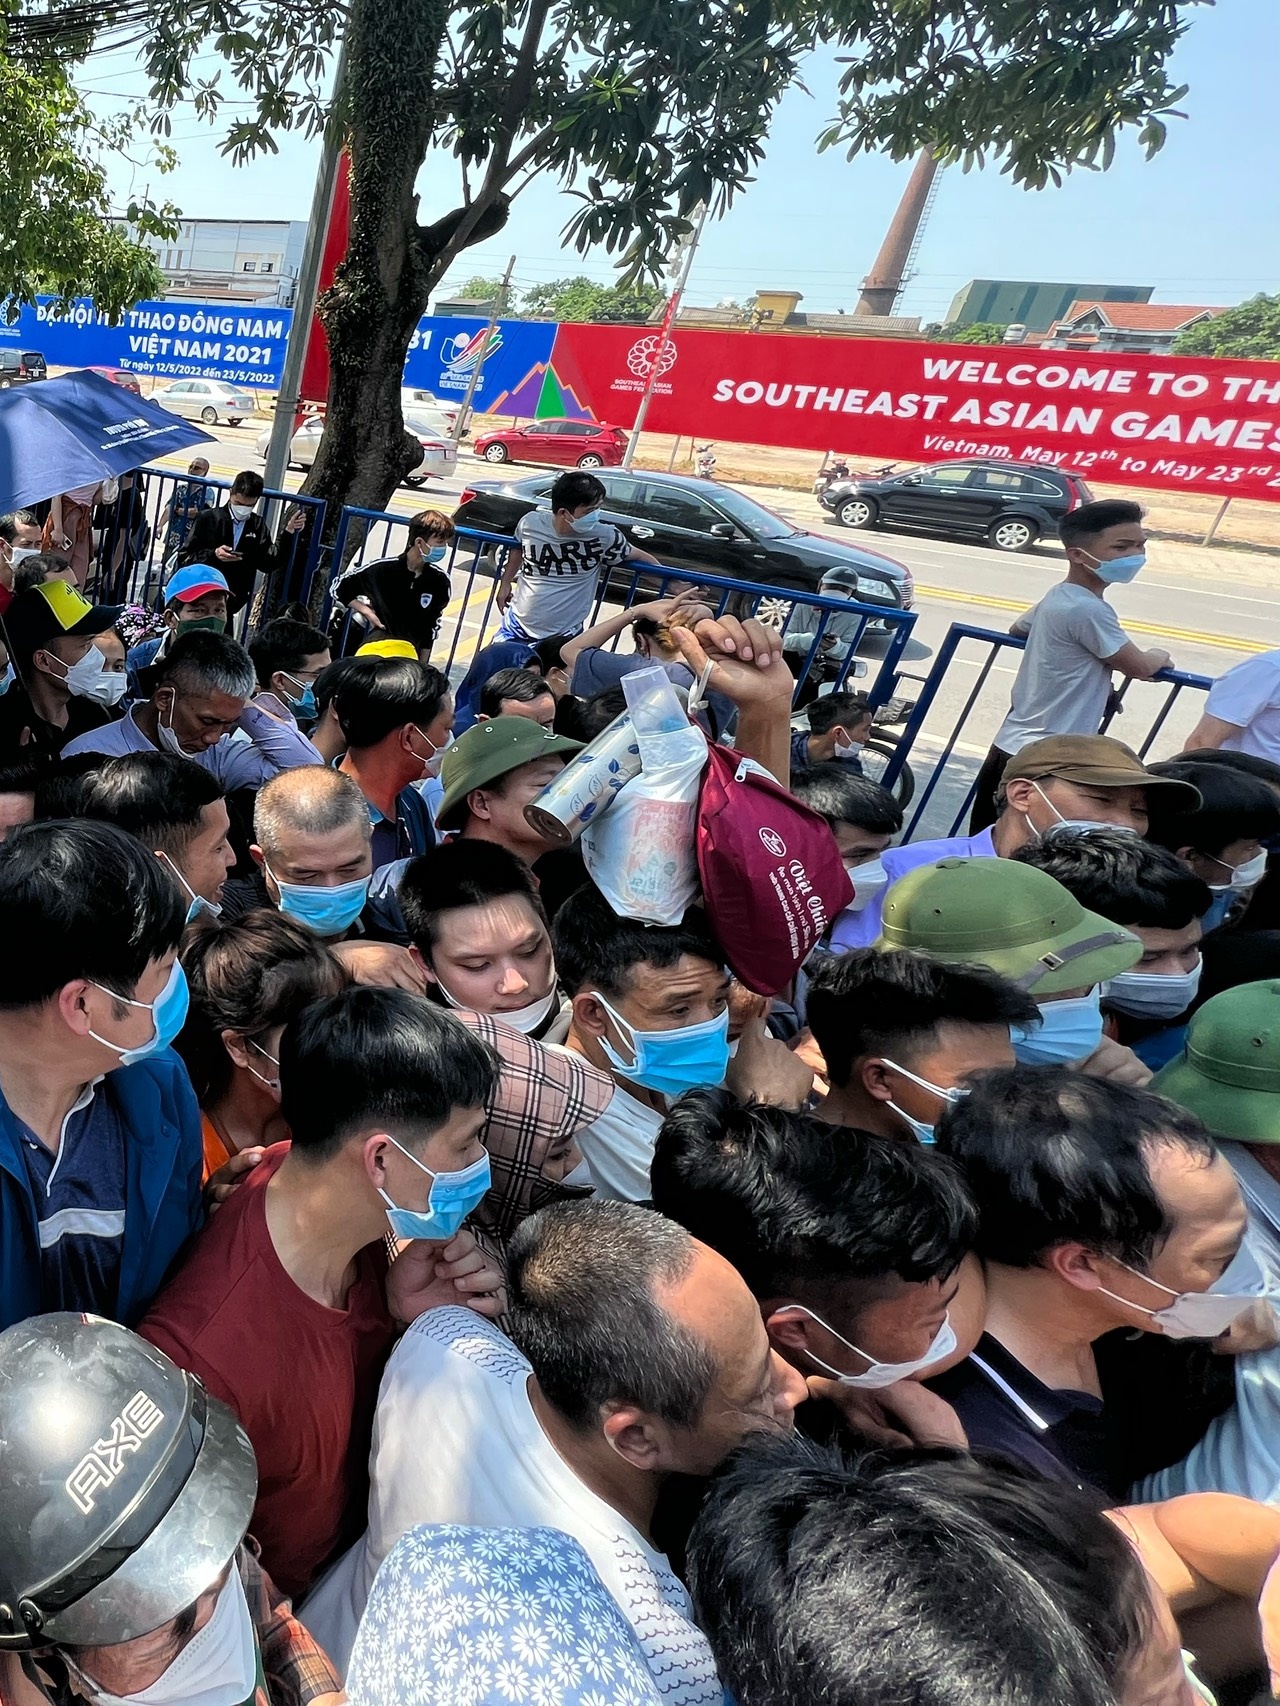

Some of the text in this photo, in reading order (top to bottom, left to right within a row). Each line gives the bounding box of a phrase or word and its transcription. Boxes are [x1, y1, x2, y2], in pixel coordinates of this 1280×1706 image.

[129, 311, 175, 331] THAO
[178, 310, 233, 336] ĐÔNG
[236, 319, 283, 340] NAM
[128, 333, 272, 365] VIỆT NAM 2021
[132, 361, 155, 374] ngày
[156, 363, 202, 377] 12/5/2022
[202, 367, 221, 379] đến
[223, 370, 275, 384] 23/5/2022
[923, 358, 1137, 394] WELCOME
[1147, 372, 1210, 398] TO
[712, 378, 948, 421] SOUTHEAST
[949, 399, 1104, 435] ASIAN
[1019, 445, 1069, 466] May
[1071, 449, 1119, 467] 12th
[1120, 456, 1147, 472] to
[1151, 460, 1206, 481] May
[1206, 465, 1272, 483] 23rd
[788, 859, 813, 896] Việt
[65, 1389, 165, 1515] AXE
